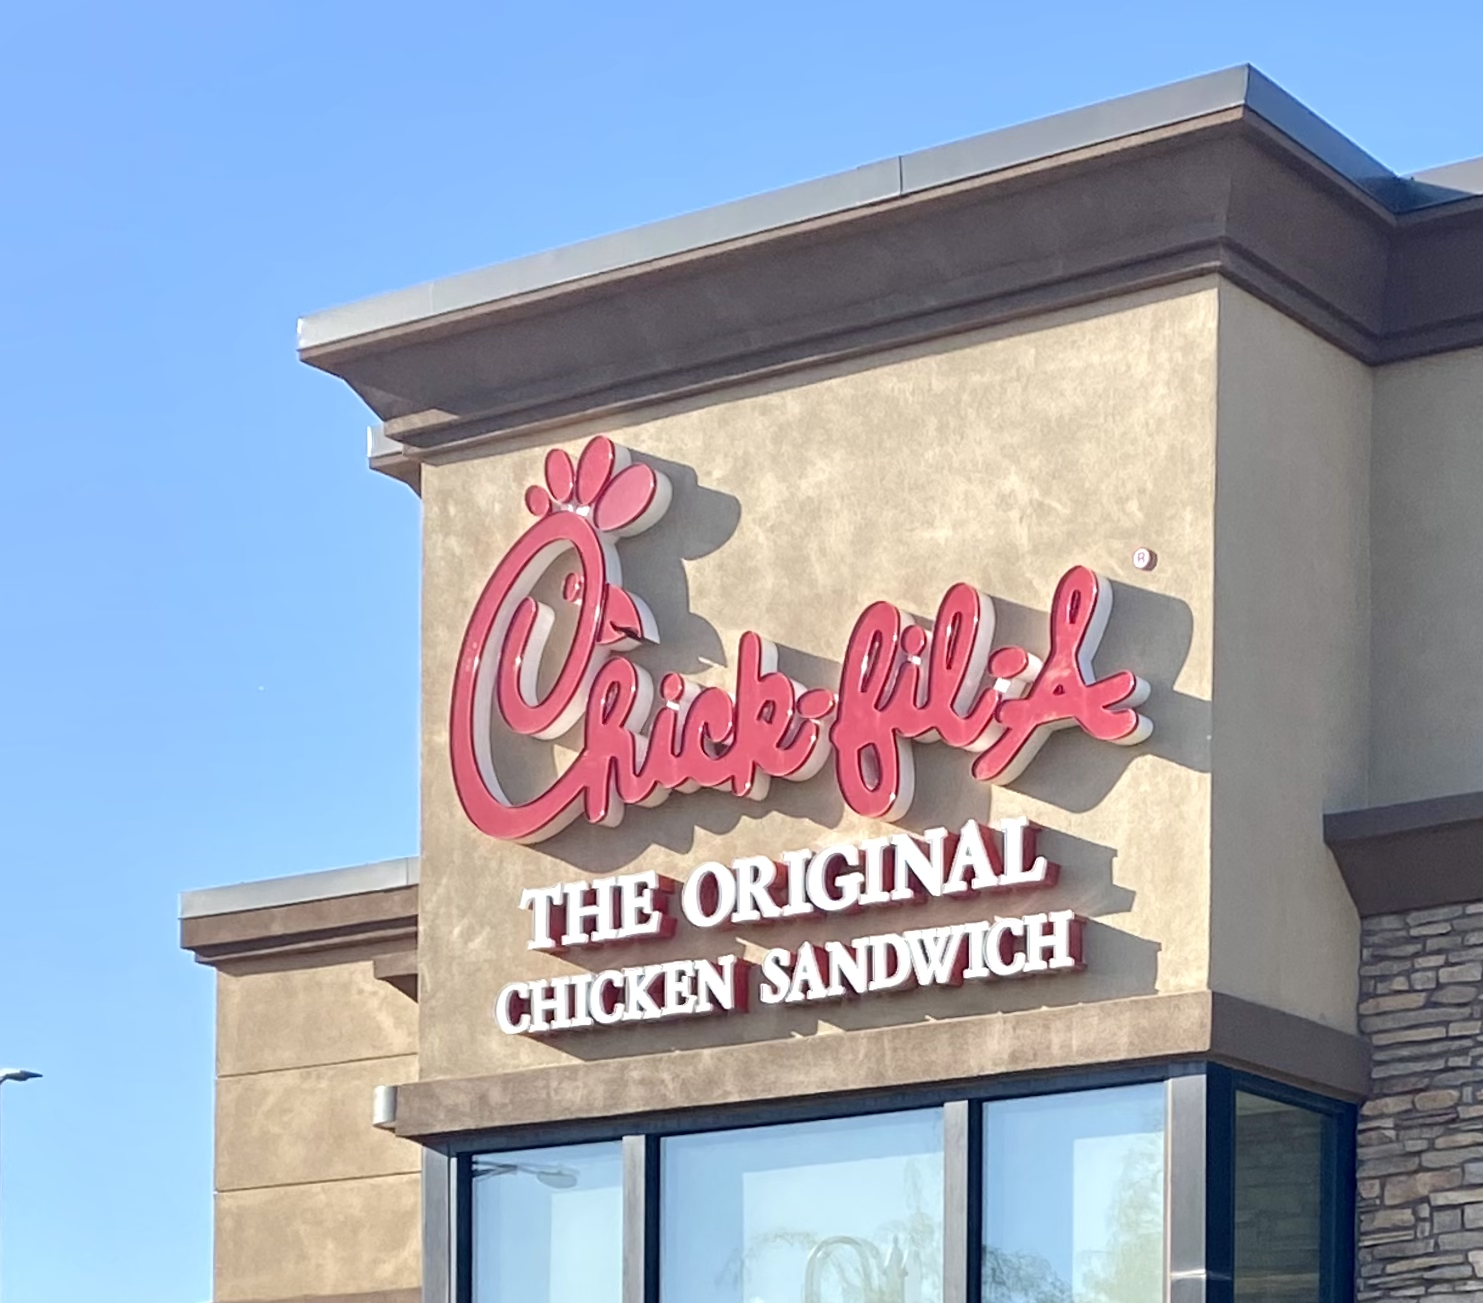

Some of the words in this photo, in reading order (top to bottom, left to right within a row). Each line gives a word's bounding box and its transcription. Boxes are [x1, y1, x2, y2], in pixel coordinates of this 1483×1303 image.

[450, 435, 1148, 844] Chick-fil-A
[519, 870, 662, 951] THE
[681, 816, 1048, 928] ORIGINAL
[495, 954, 736, 1035] CHICKEN
[760, 910, 1077, 1004] SANDWICH
